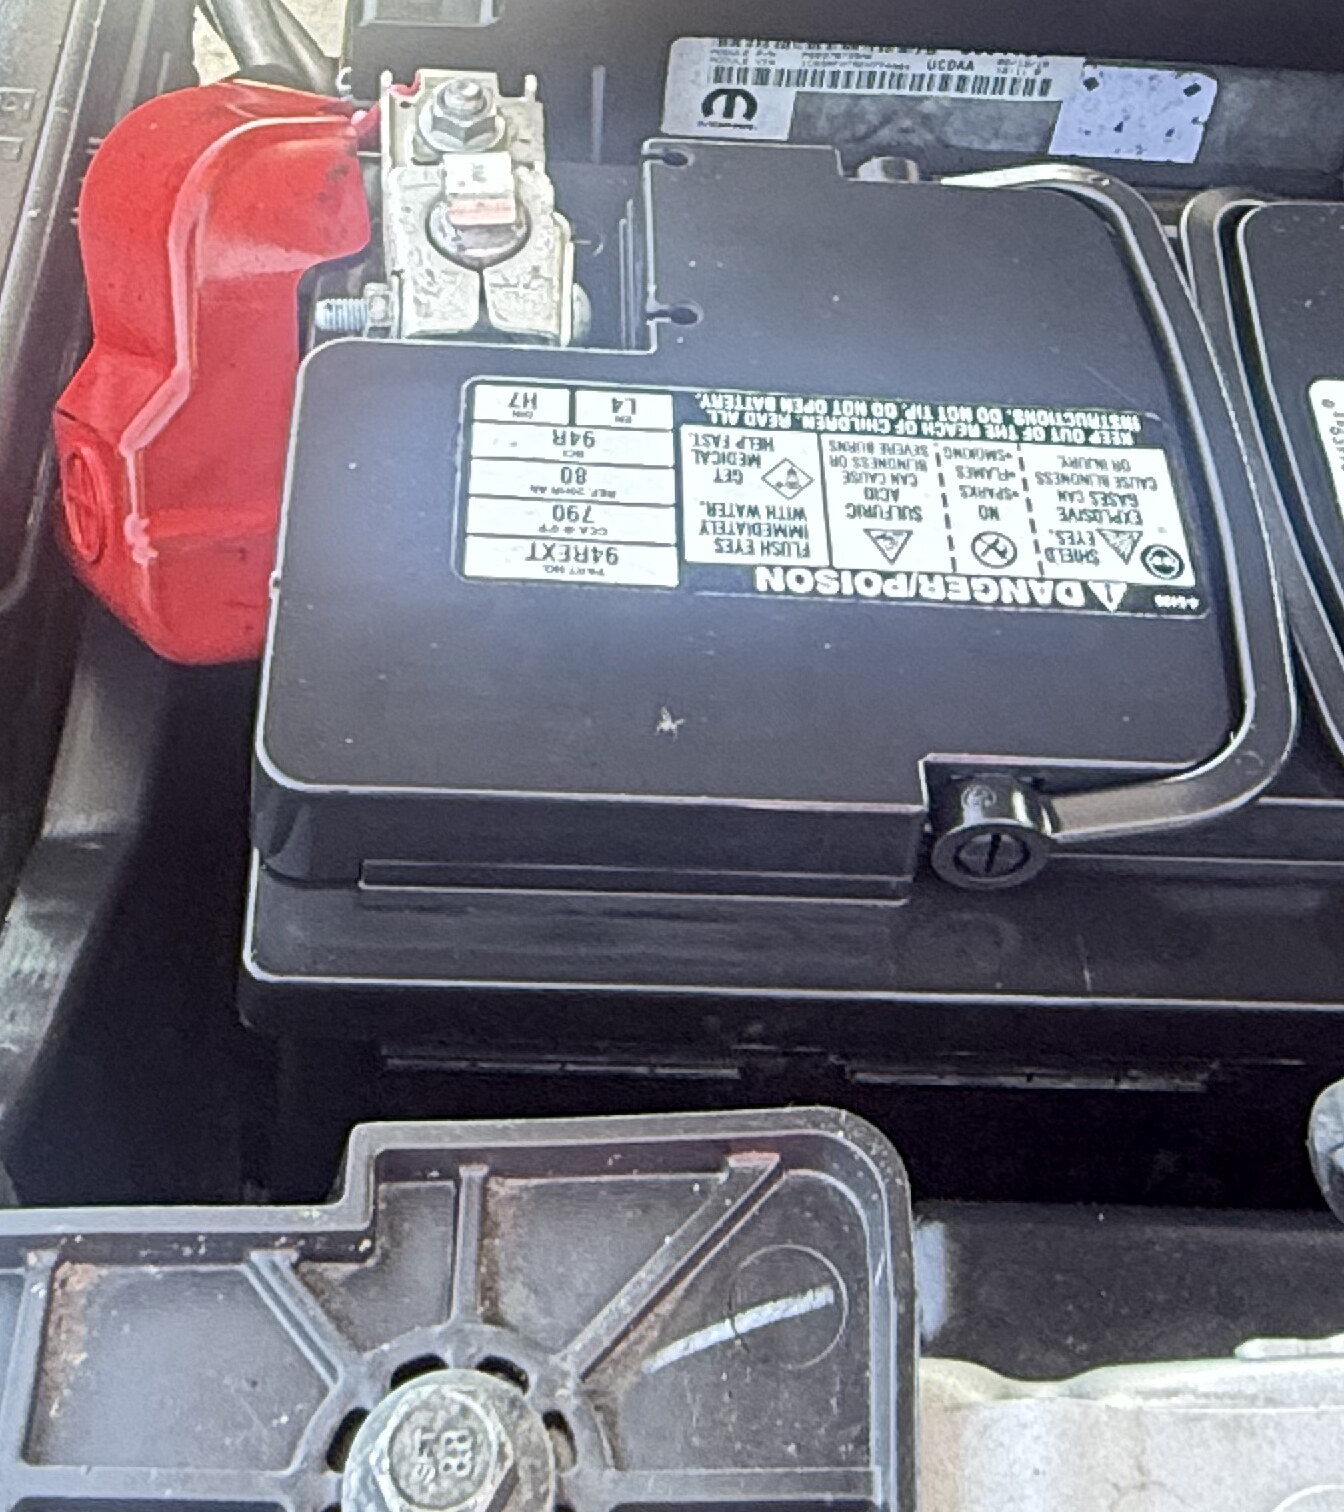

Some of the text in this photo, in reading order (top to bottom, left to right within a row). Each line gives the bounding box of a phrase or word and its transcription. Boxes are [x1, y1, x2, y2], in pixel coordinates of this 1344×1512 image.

[926, 57, 974, 72] UCDAA
[507, 390, 537, 409] H7
[610, 396, 636, 414] L4
[693, 392, 775, 411] BATTERY.
[780, 396, 827, 414] OPEN
[832, 399, 866, 416] NOT
[870, 401, 897, 417] DO
[938, 405, 972, 421] NOT
[977, 407, 1001, 422] DO
[1005, 407, 1141, 431] INSTRUCTIONS.
[706, 409, 1135, 446] KEEP OUT OF THE REACH OF CHILDREN. READ ALL
[551, 428, 595, 448] 94R
[688, 432, 774, 451] HELP FAST.
[690, 448, 761, 467] MEDICAL
[878, 441, 928, 457] SEVERE
[828, 454, 927, 471] BLINDNESS OR
[560, 466, 587, 485] 80
[713, 467, 743, 484] GET
[841, 470, 917, 487] CAN CAUSE
[1034, 470, 1157, 491] CAUSE BLINDNESS
[863, 486, 899, 502] ACID
[1056, 489, 1137, 507] GASES CAN
[551, 503, 595, 523] 790
[698, 500, 806, 521] WITH WATER.
[844, 502, 922, 522] SULFURIC
[977, 504, 1000, 521] NO
[1056, 505, 1143, 525] EXPLOSIVE
[699, 518, 808, 539] IMMEDIATELY
[524, 541, 619, 565] 94REXT
[713, 537, 810, 558] FLUSH EYES
[1043, 546, 1099, 566] SHIELD
[752, 564, 1085, 607] DANGER/POISON
